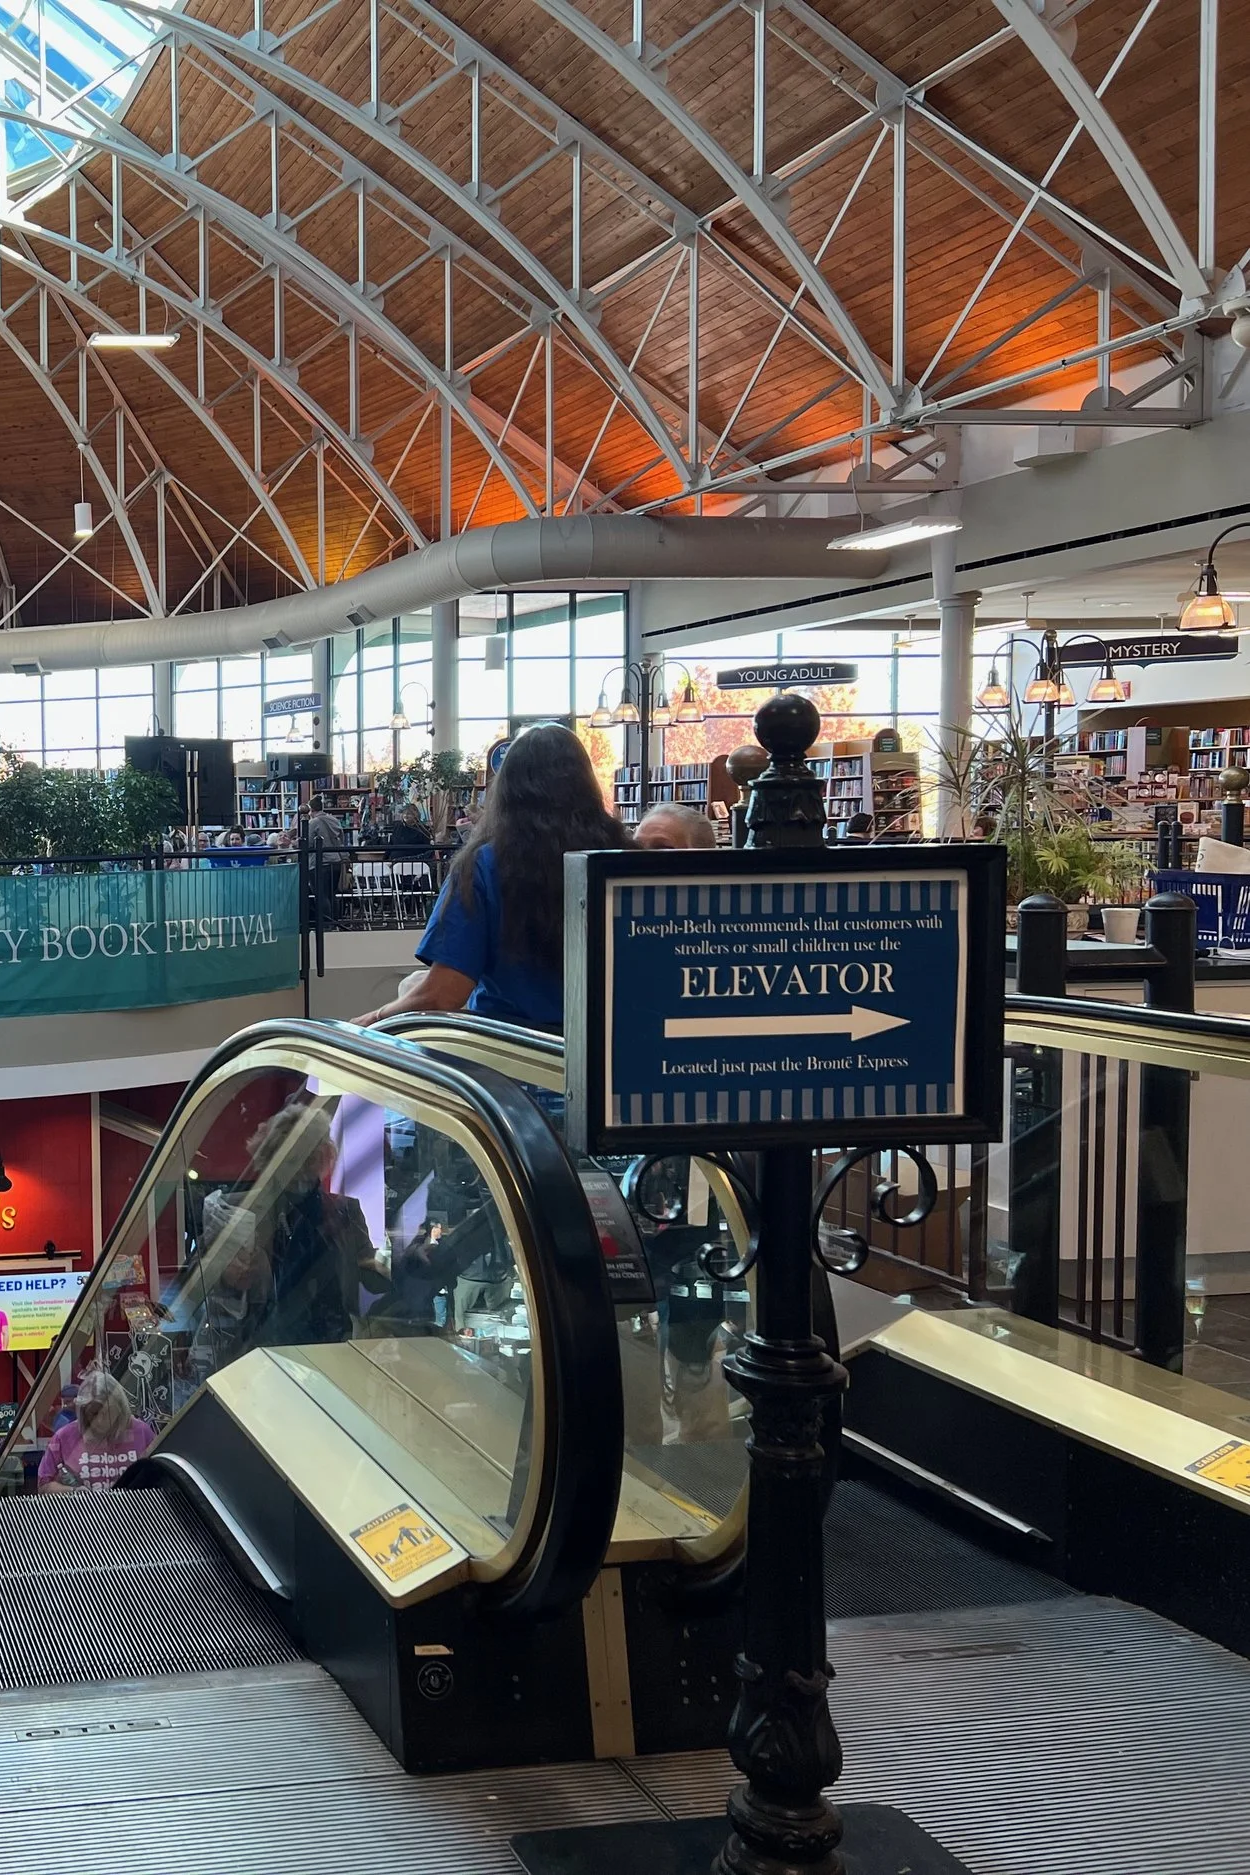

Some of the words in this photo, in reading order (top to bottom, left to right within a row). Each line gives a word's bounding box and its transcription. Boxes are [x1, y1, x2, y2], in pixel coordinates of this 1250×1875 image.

[1108, 641, 1181, 658] MYSTERY
[737, 668, 788, 683] YOUNG
[789, 666, 836, 680] ADULT
[269, 700, 292, 712] SCIENCE
[291, 697, 315, 709] FICTION
[39, 921, 158, 962] BOOK
[163, 912, 279, 954] FESTIVAL
[627, 919, 717, 938] Joseph-Beth
[720, 917, 810, 934] recommends
[813, 917, 840, 931] that
[844, 917, 912, 931] customers
[915, 914, 943, 930] with
[674, 940, 729, 955] strollers
[733, 943, 750, 954] or
[751, 939, 789, 953] small
[792, 937, 850, 953] children
[853, 941, 876, 952] use
[879, 936, 901, 951] the
[680, 961, 896, 998] ELEVATOR
[661, 1058, 718, 1075] Located
[719, 1058, 746, 1077] just
[749, 1059, 777, 1076] past
[781, 1056, 802, 1072] the
[807, 1055, 853, 1071] Brontë
[857, 1053, 909, 1072] Express
[25, 1278, 67, 1291] HELP?
[1194, 1444, 1235, 1468] CAUTION
[360, 1507, 401, 1533] CAUTION
